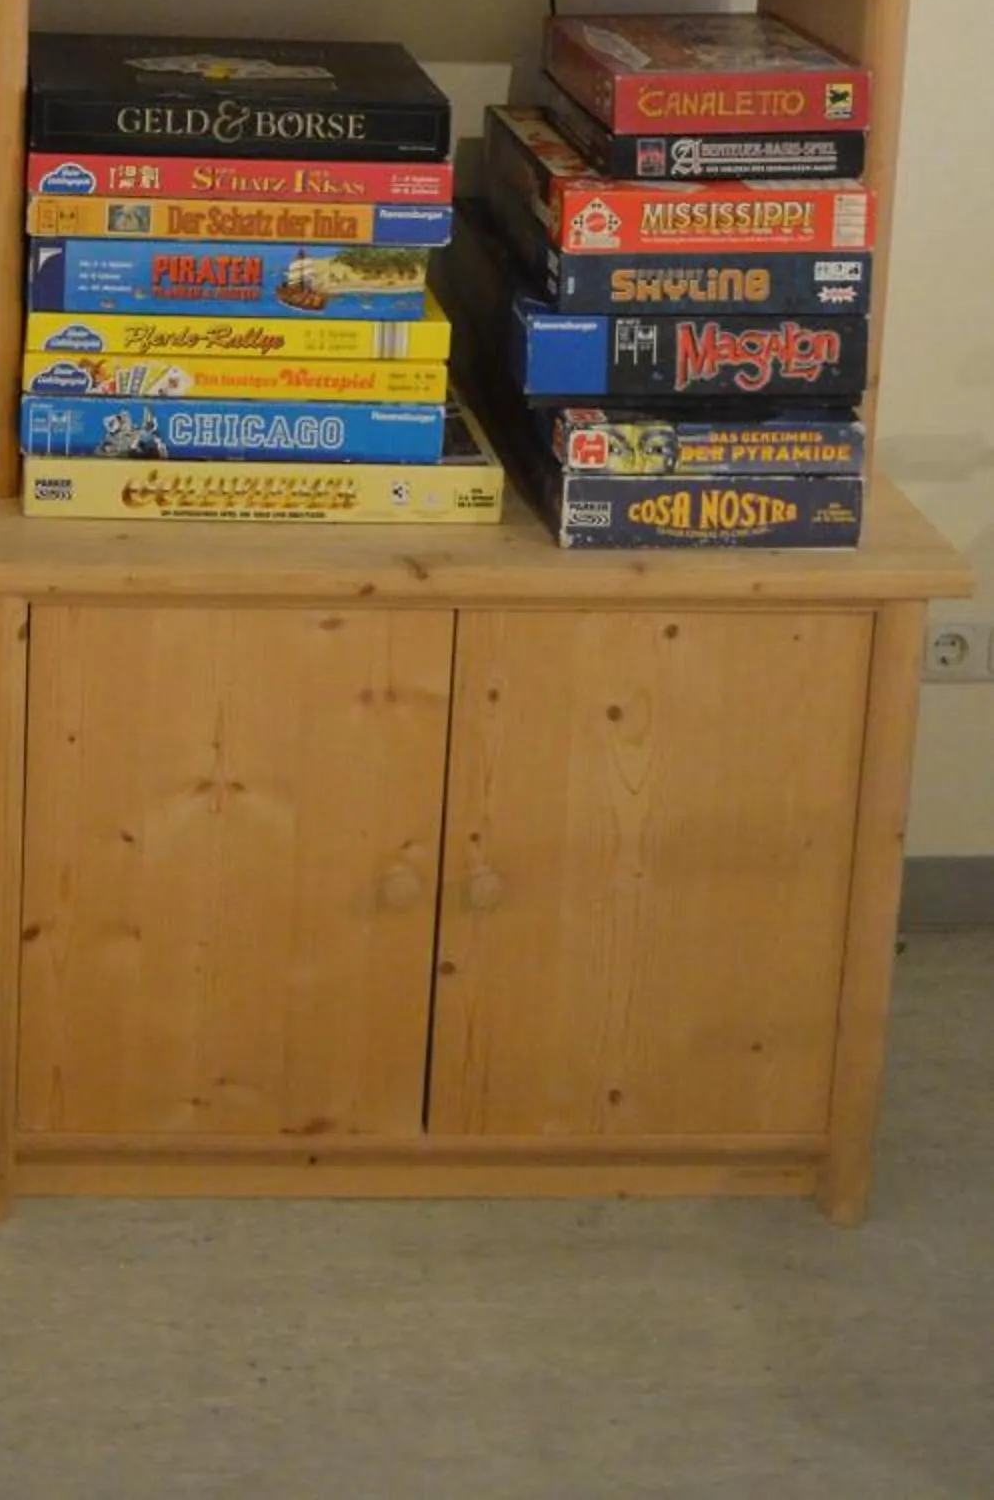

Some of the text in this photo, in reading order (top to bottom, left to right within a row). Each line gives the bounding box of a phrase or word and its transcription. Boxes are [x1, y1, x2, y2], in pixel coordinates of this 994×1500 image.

[637, 86, 806, 119] CANALETTO
[116, 107, 211, 135] GELD
[211, 99, 250, 143] &
[167, 205, 359, 239] Der Schatz der Inka
[640, 202, 815, 232] MISSISSIPPI
[152, 254, 264, 287] PIRATEN
[122, 324, 287, 352] Pferde-Rallye
[279, 368, 376, 393] Wettspiel
[168, 412, 346, 450] CHICAGO
[730, 443, 853, 463] PYRAMIDE
[627, 490, 693, 525] COSA
[701, 488, 798, 530] NOSTRA
